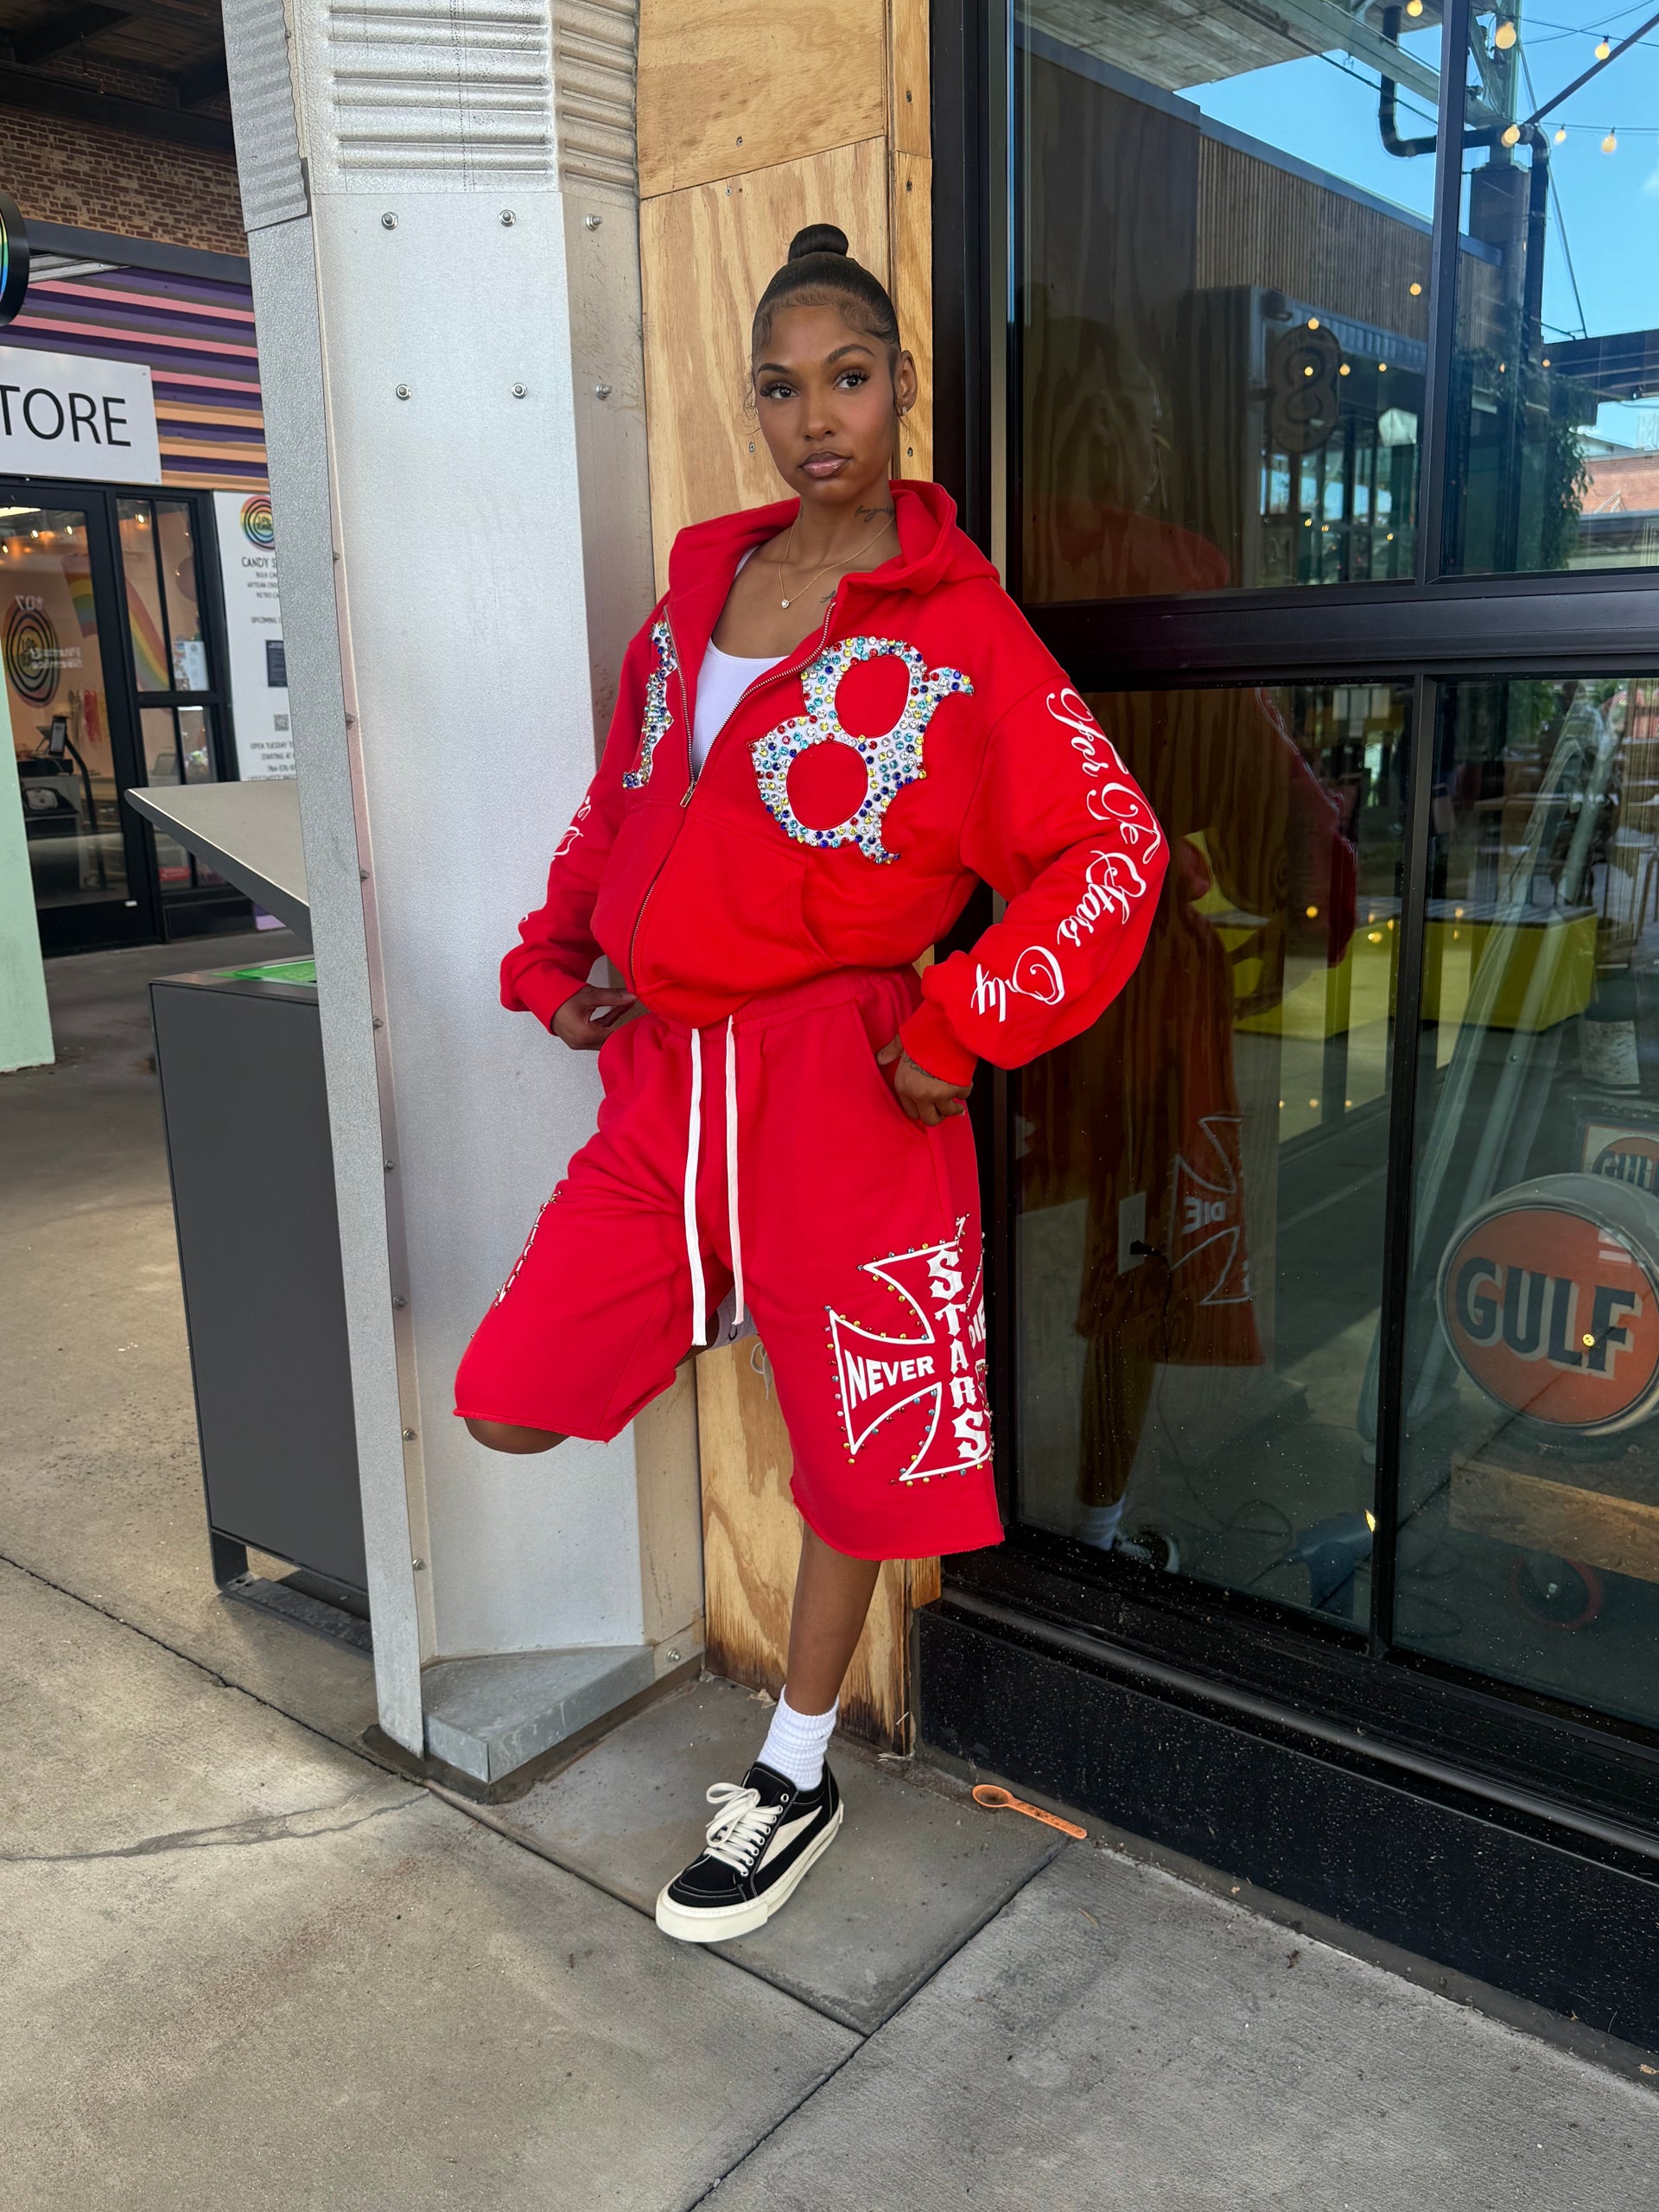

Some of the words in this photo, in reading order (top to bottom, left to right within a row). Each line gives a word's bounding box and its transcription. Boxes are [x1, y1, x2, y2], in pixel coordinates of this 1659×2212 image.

[0, 385, 131, 447] TORE
[241, 556, 269, 568] CANDY
[1046, 688, 1129, 778] For
[926, 1249, 988, 1460] STARS
[1455, 1256, 1639, 1379] GULF
[844, 1349, 936, 1410] NEVER
